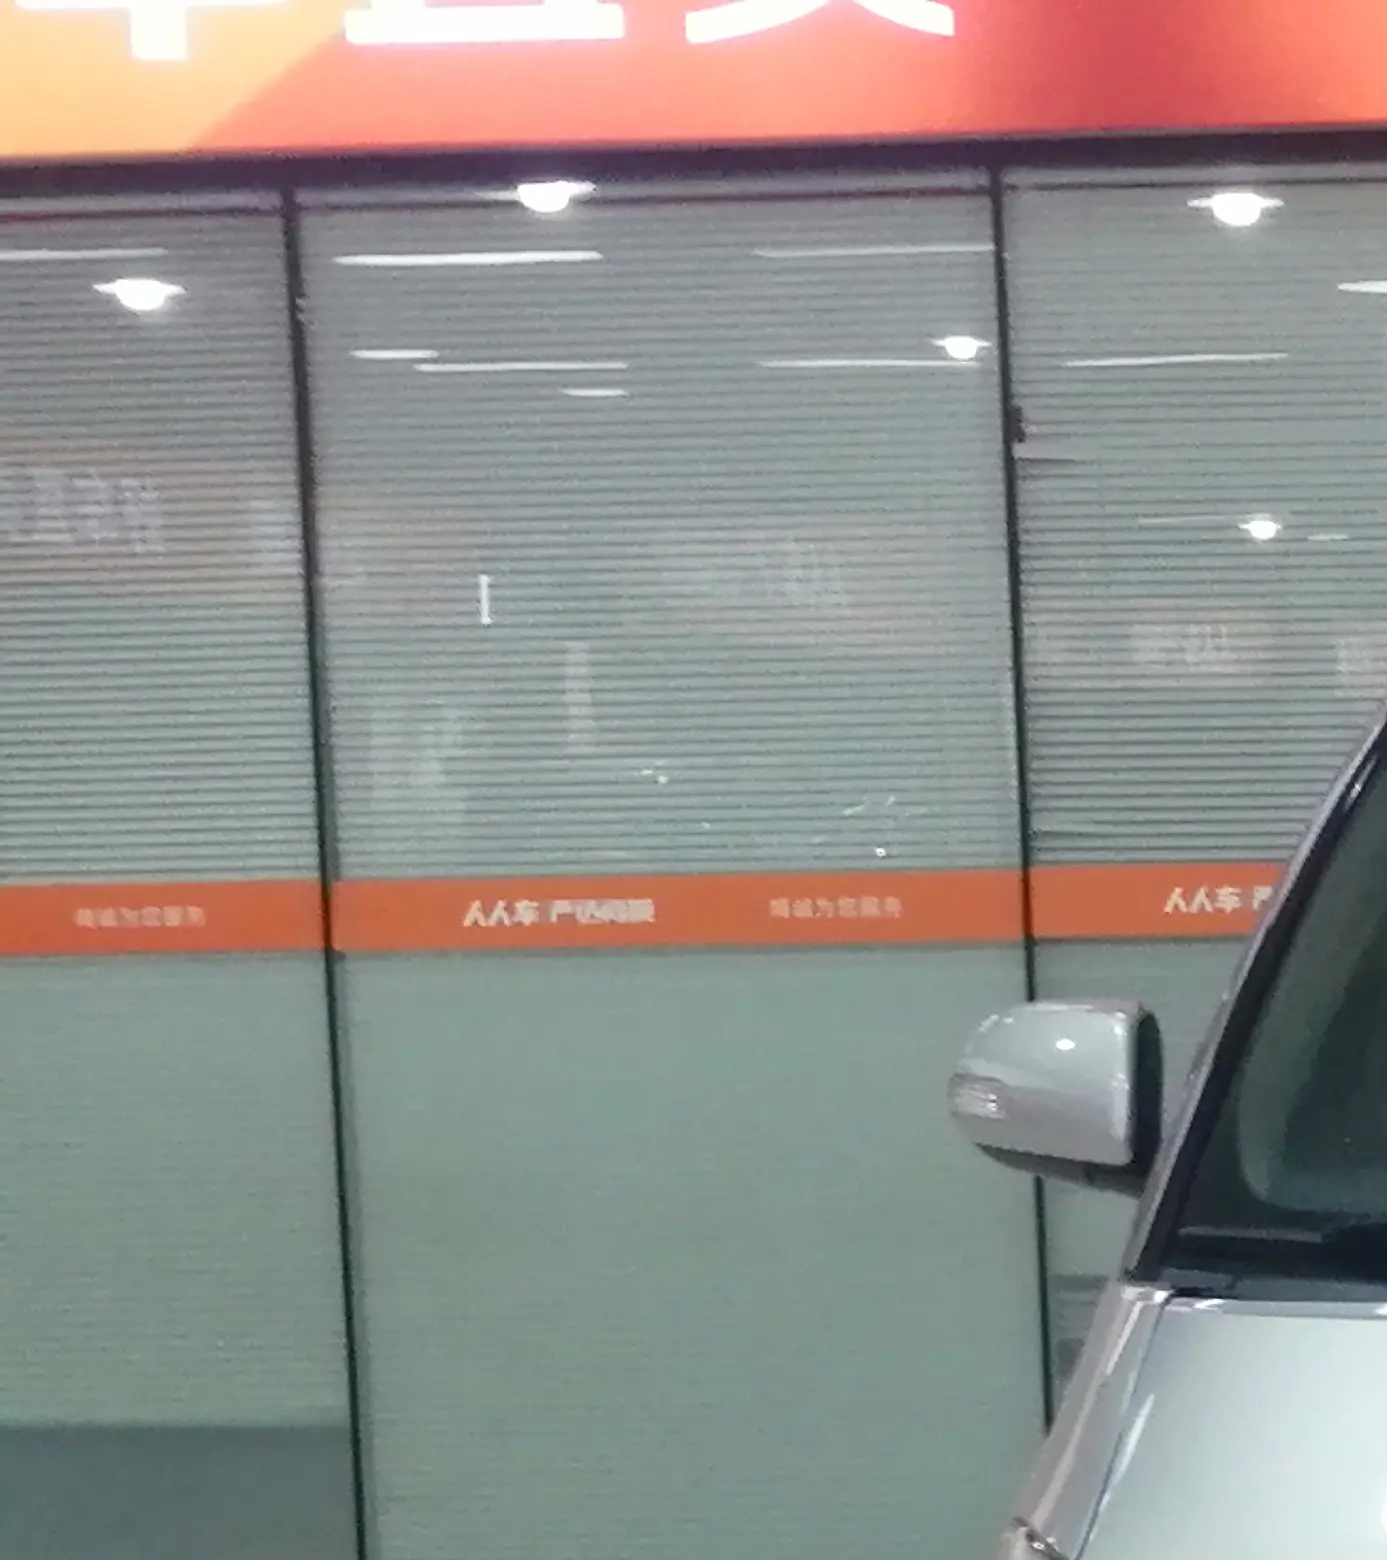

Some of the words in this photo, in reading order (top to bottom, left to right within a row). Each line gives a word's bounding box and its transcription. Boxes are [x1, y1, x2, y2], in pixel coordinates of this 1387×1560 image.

[462, 899, 540, 927] 人人车
[1163, 885, 1243, 914] 人人车
